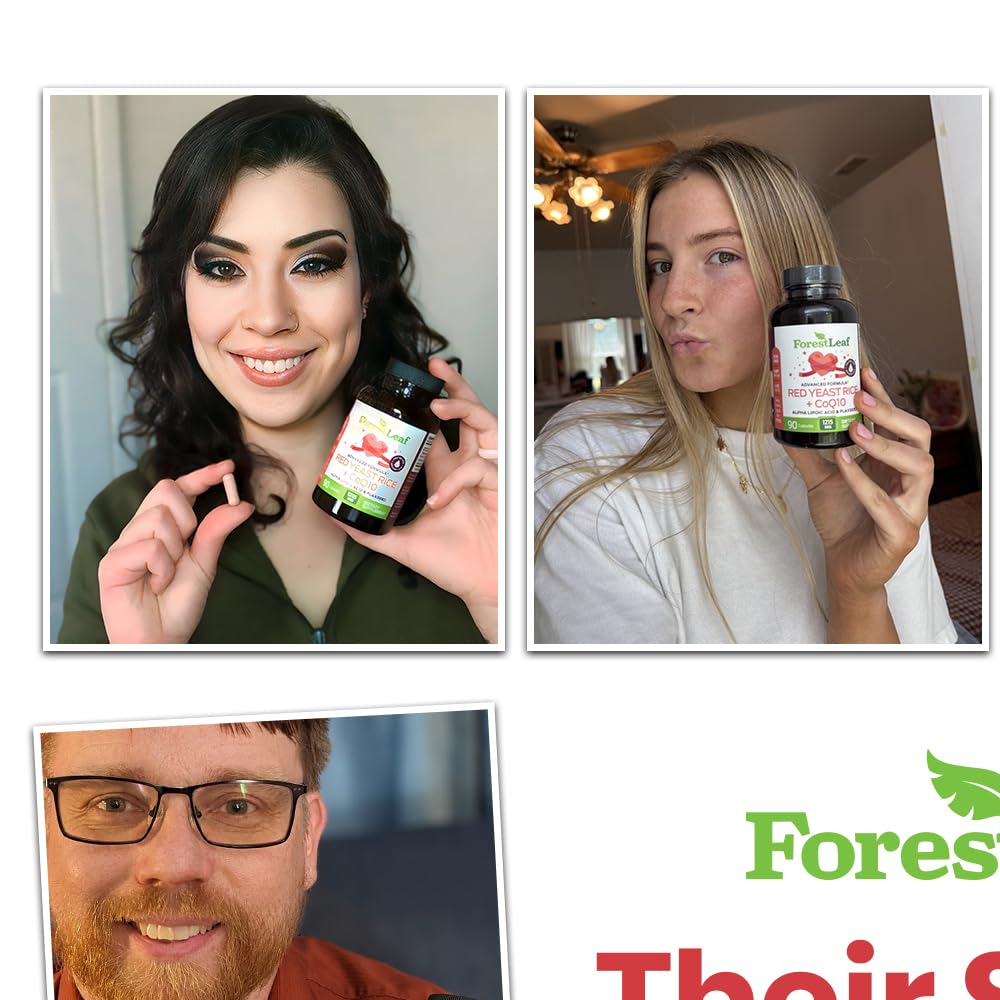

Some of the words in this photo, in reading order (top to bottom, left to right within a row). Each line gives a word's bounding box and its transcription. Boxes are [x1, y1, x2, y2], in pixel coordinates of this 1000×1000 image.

[793, 337, 850, 349] ForestLeaf
[788, 389, 807, 398] RED
[808, 388, 841, 398] YEAST
[843, 386, 858, 395] RICE
[815, 398, 846, 408] CoQ10
[788, 420, 798, 430] 90
[336, 454, 349, 467] RED
[351, 462, 379, 480] YEAST
[378, 475, 398, 489] RICE
